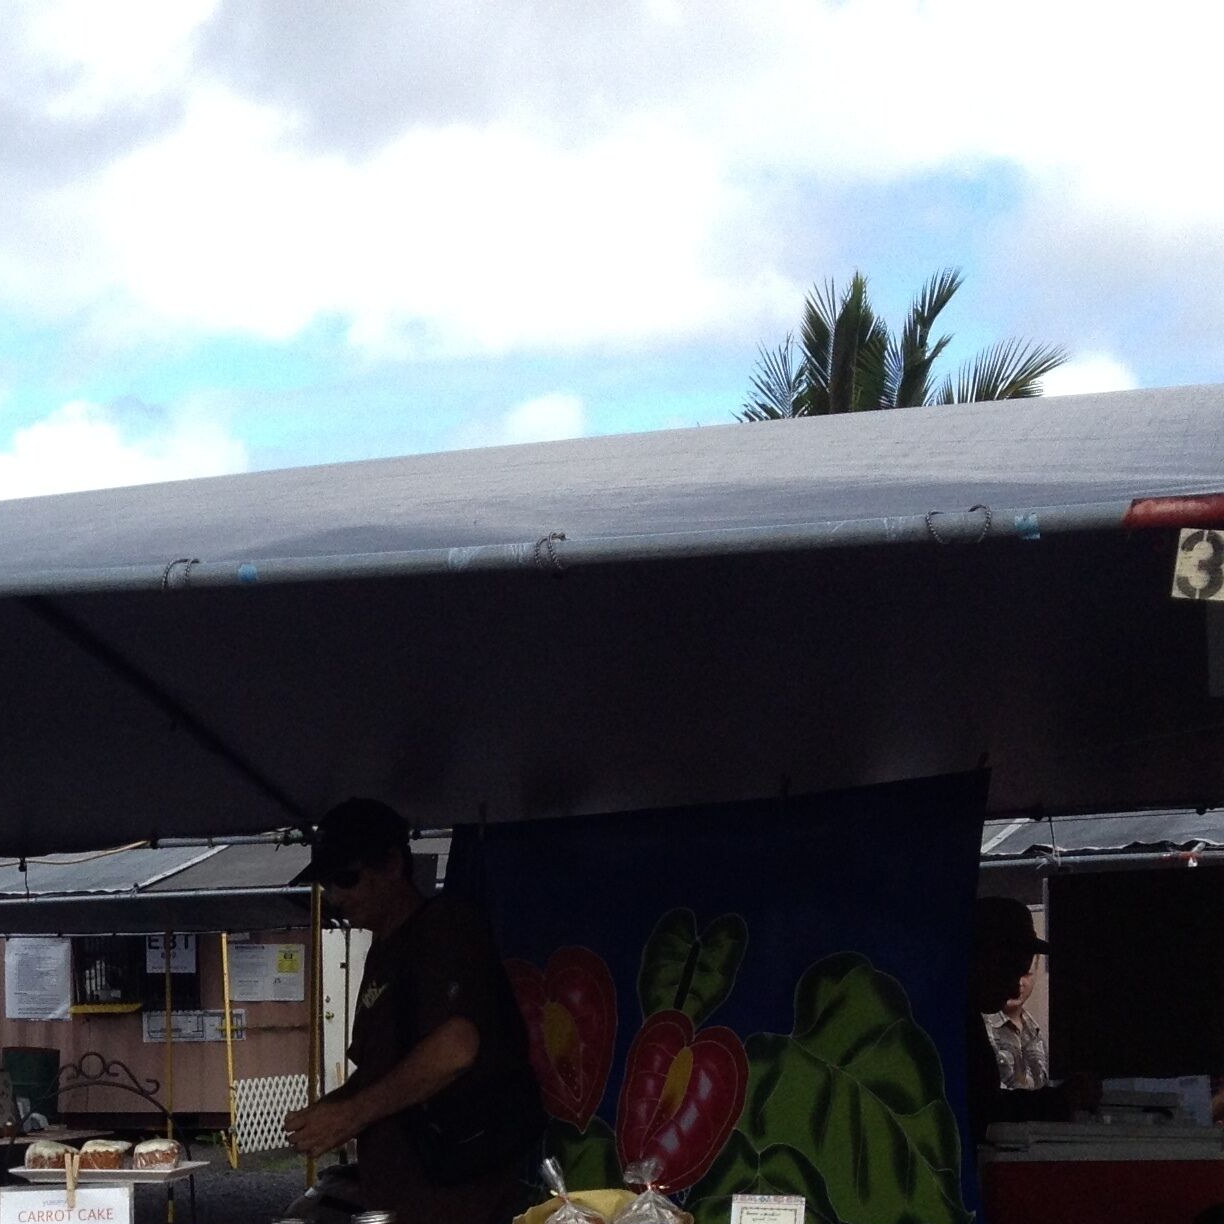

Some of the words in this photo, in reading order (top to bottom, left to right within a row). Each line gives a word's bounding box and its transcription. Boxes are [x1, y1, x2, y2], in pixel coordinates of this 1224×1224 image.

[1176, 530, 1224, 599] 3
[18, 1209, 73, 1223] CARROT
[78, 1207, 114, 1221] CAKE
